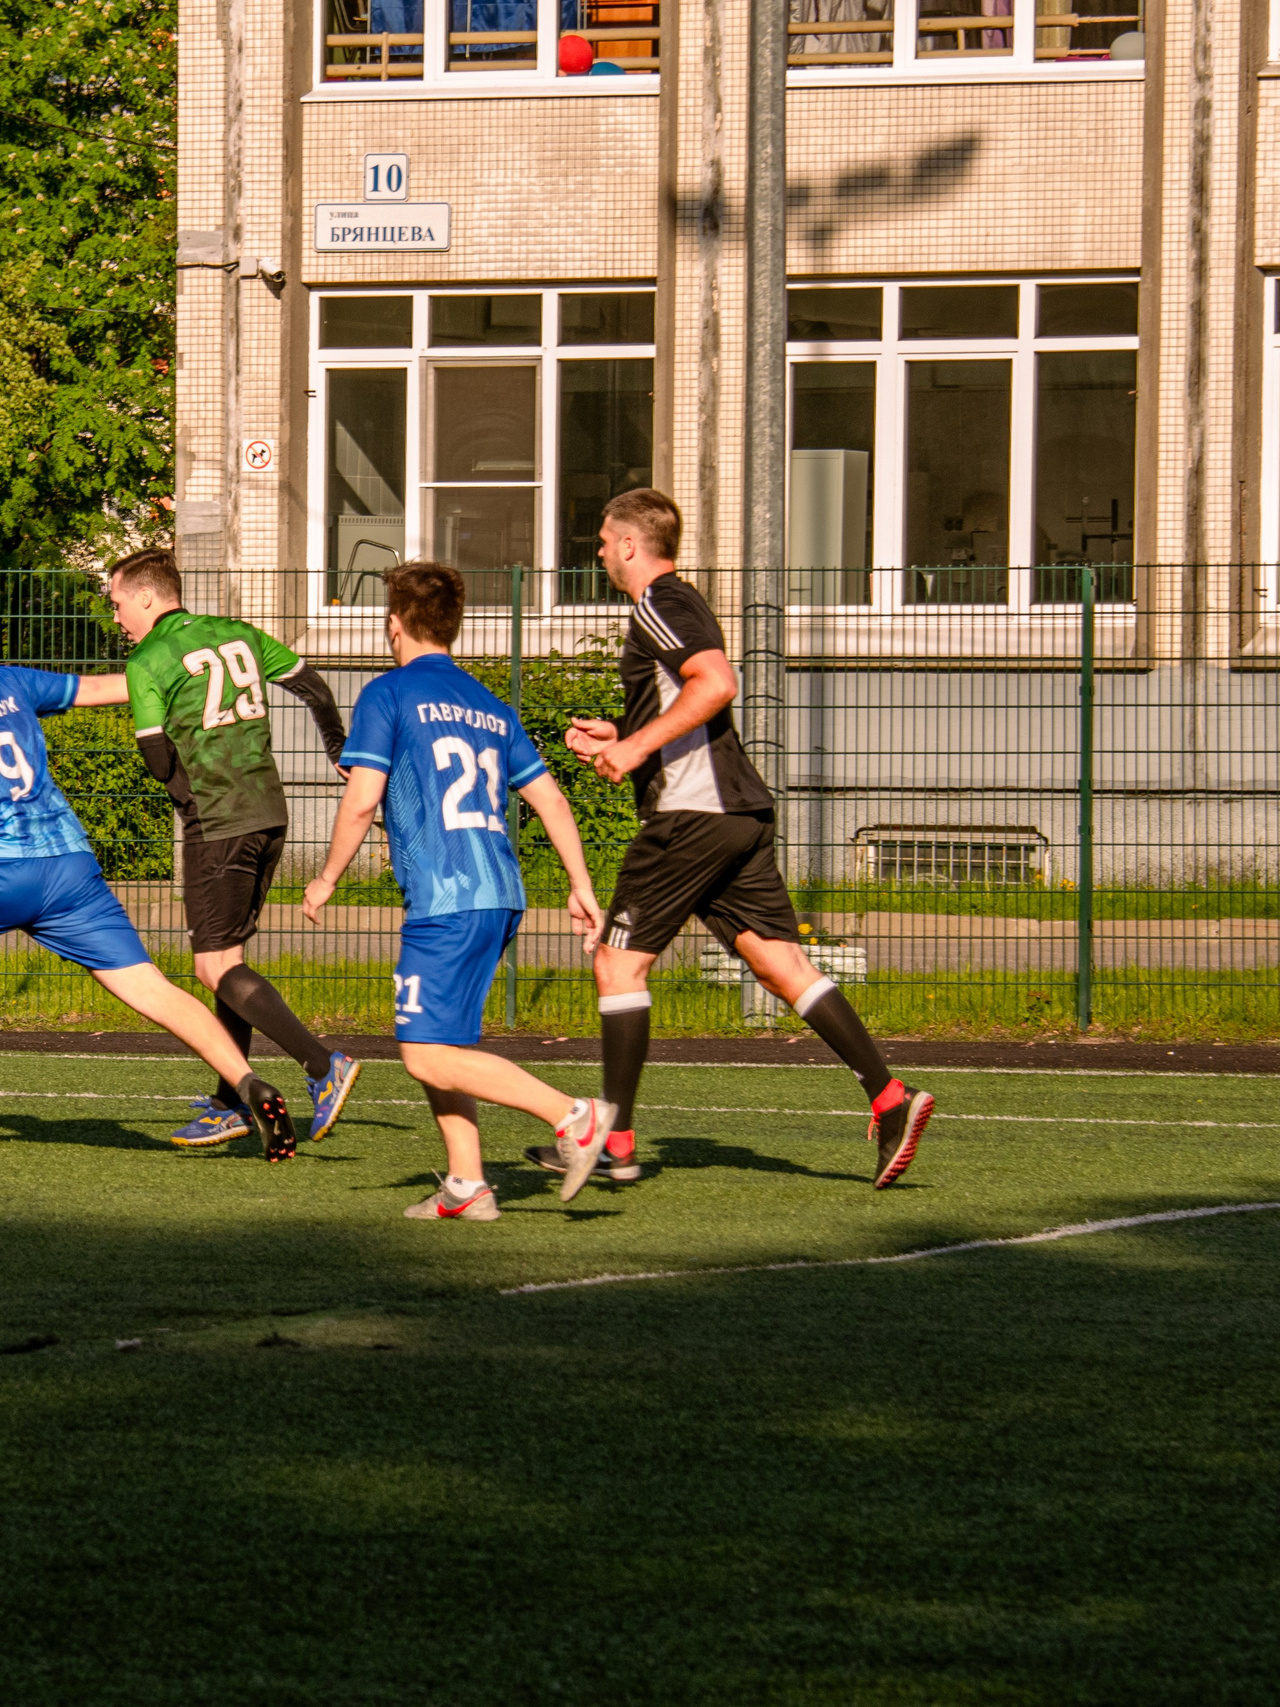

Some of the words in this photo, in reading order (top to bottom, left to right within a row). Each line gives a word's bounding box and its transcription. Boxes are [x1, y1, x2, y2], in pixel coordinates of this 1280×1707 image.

[369, 163, 403, 193] 10
[329, 210, 359, 220] улица
[330, 226, 436, 244] БРЯНЦЕВА
[182, 640, 266, 731] 29
[431, 736, 507, 835] 21
